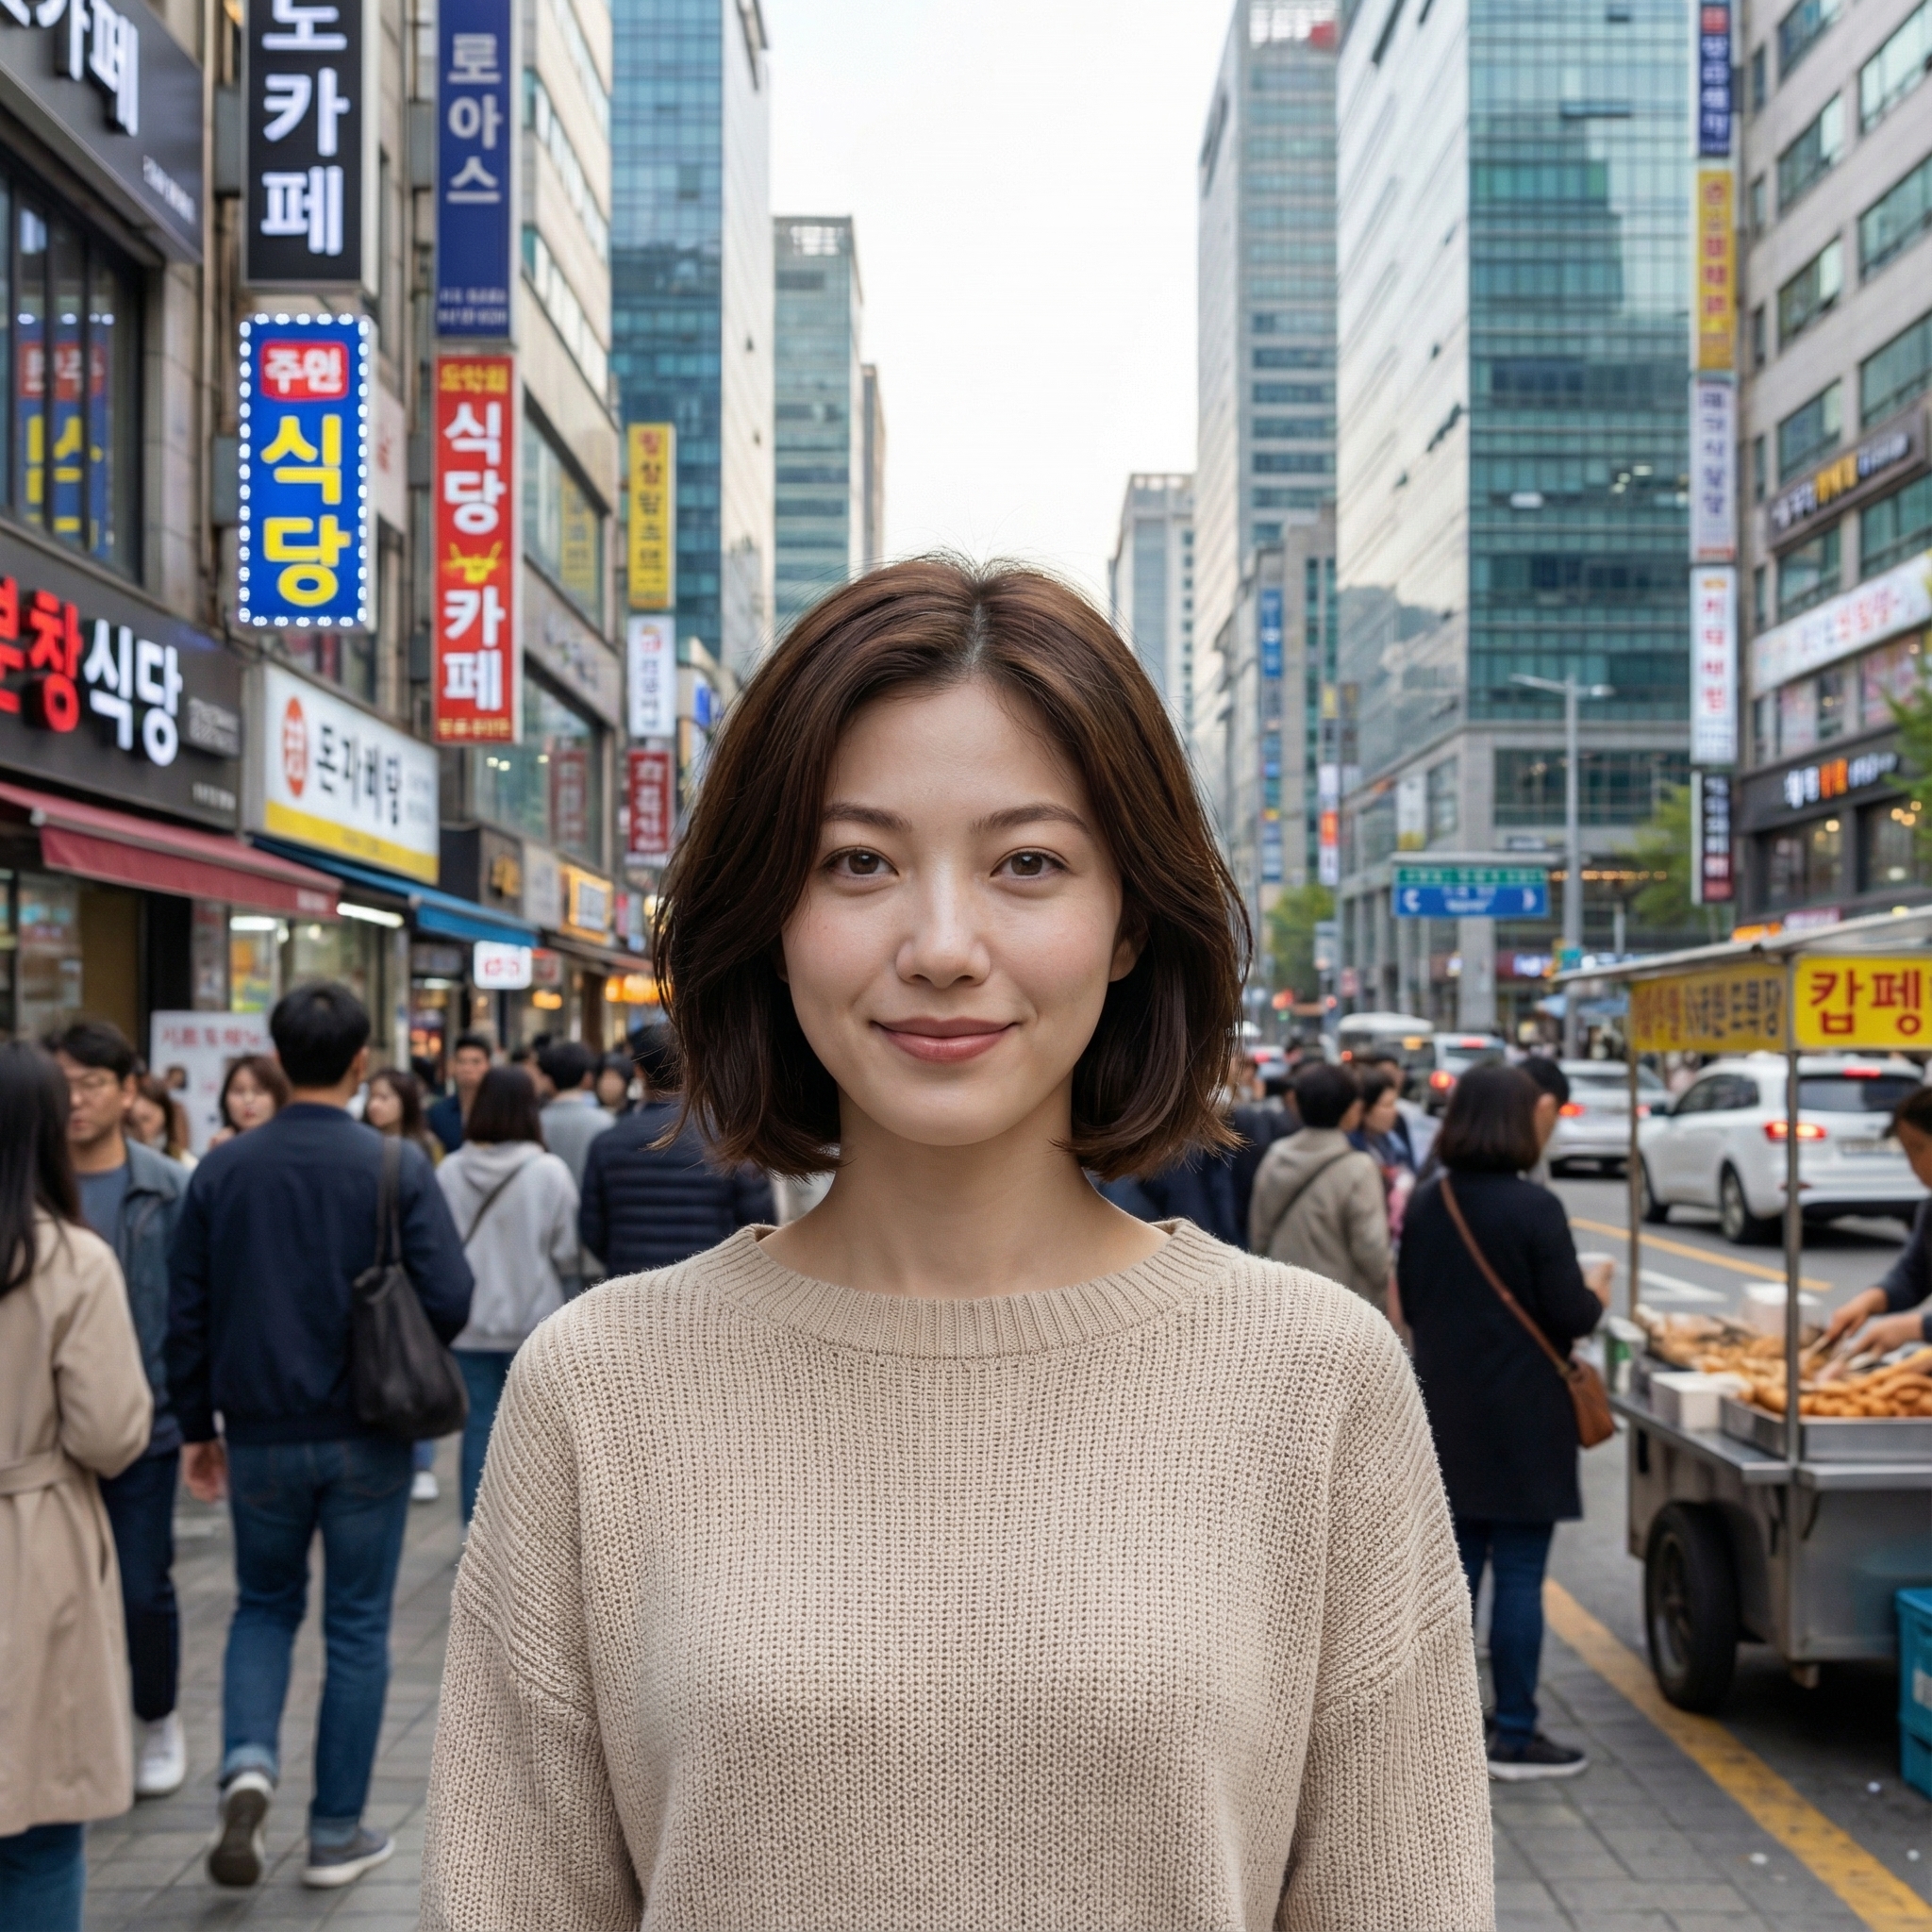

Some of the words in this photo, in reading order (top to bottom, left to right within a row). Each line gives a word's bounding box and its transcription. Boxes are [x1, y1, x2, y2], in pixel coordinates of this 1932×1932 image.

[446, 33, 503, 204] 로아스
[260, 413, 351, 608] 식당
[443, 402, 507, 535] 식당
[443, 585, 507, 711] 카페
